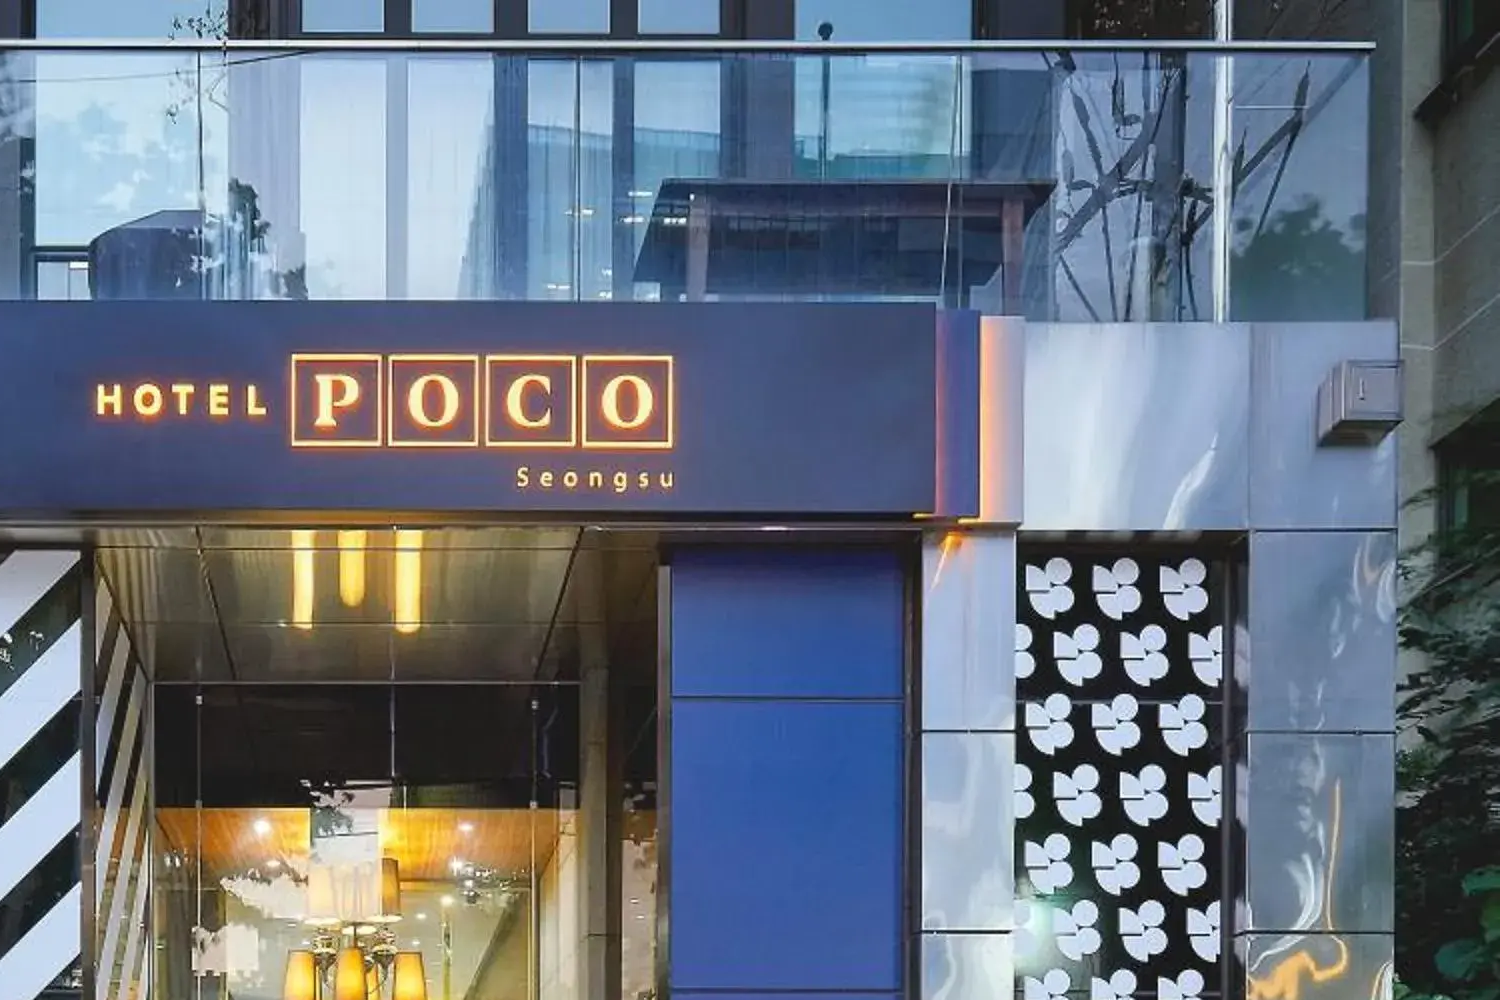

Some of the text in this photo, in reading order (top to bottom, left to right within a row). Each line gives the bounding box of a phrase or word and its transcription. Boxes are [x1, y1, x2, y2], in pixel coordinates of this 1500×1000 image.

[96, 372, 655, 430] HOTEL POCO
[516, 466, 674, 493] Seongsu
